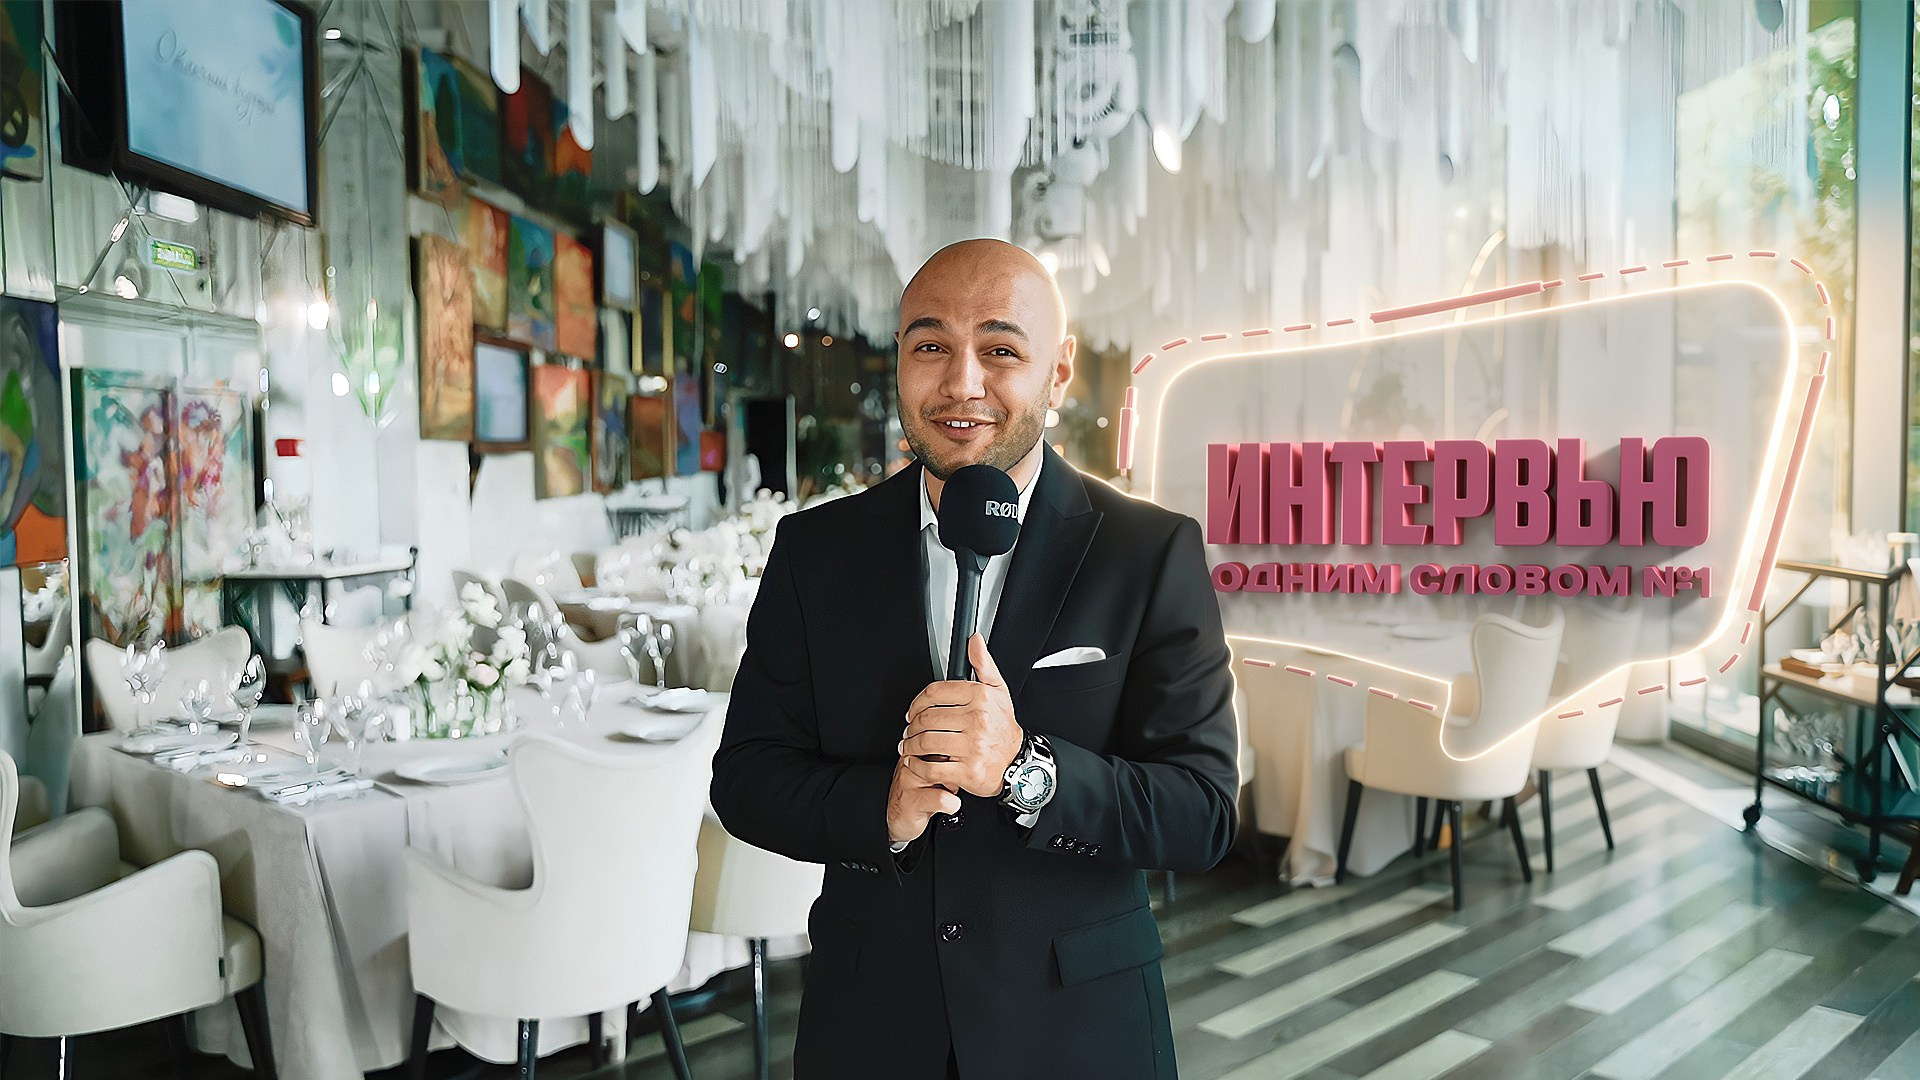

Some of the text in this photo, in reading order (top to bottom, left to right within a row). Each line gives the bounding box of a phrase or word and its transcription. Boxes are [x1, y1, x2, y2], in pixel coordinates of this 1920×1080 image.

[1206, 436, 1711, 547] ИНТЕРВЬЮ
[1210, 562, 1712, 598] ОДНИМ СЛОВОМ №1
